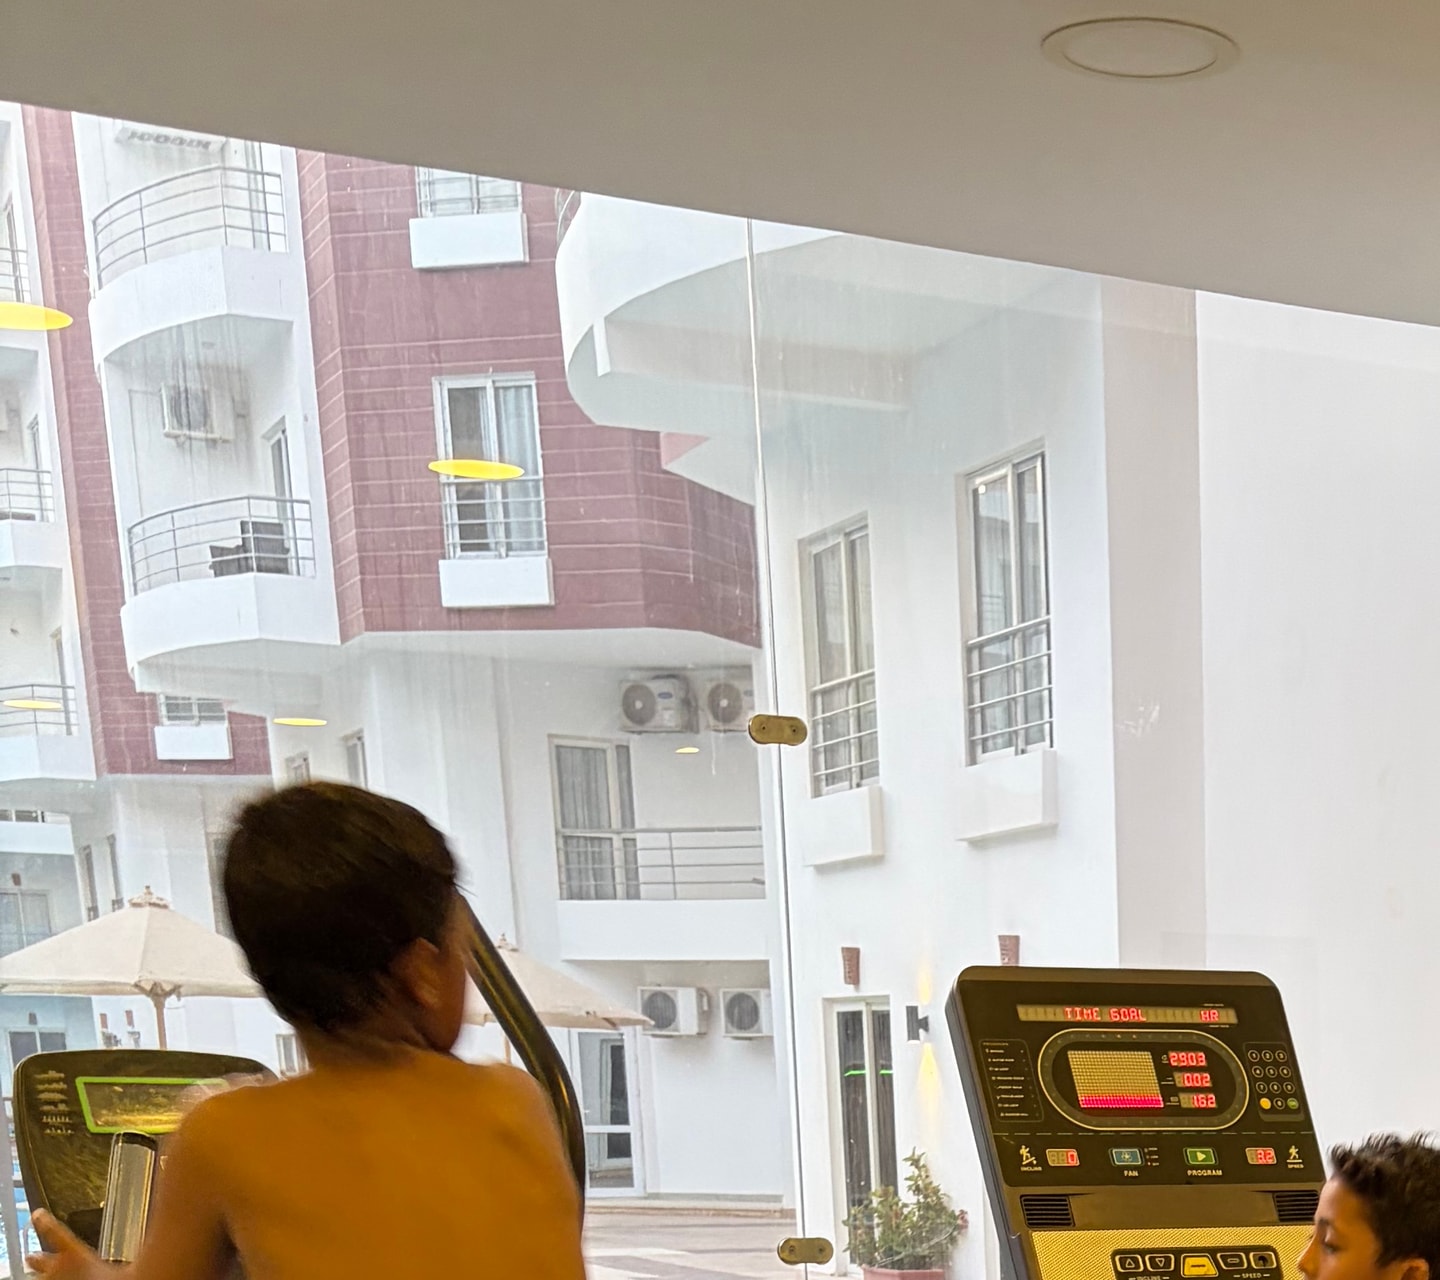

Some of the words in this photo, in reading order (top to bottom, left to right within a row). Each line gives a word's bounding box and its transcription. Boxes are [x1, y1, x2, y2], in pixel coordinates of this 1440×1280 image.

[1064, 1007, 1101, 1021] TIME
[1109, 1008, 1147, 1022] GOAL
[1200, 1010, 1219, 1022] HR
